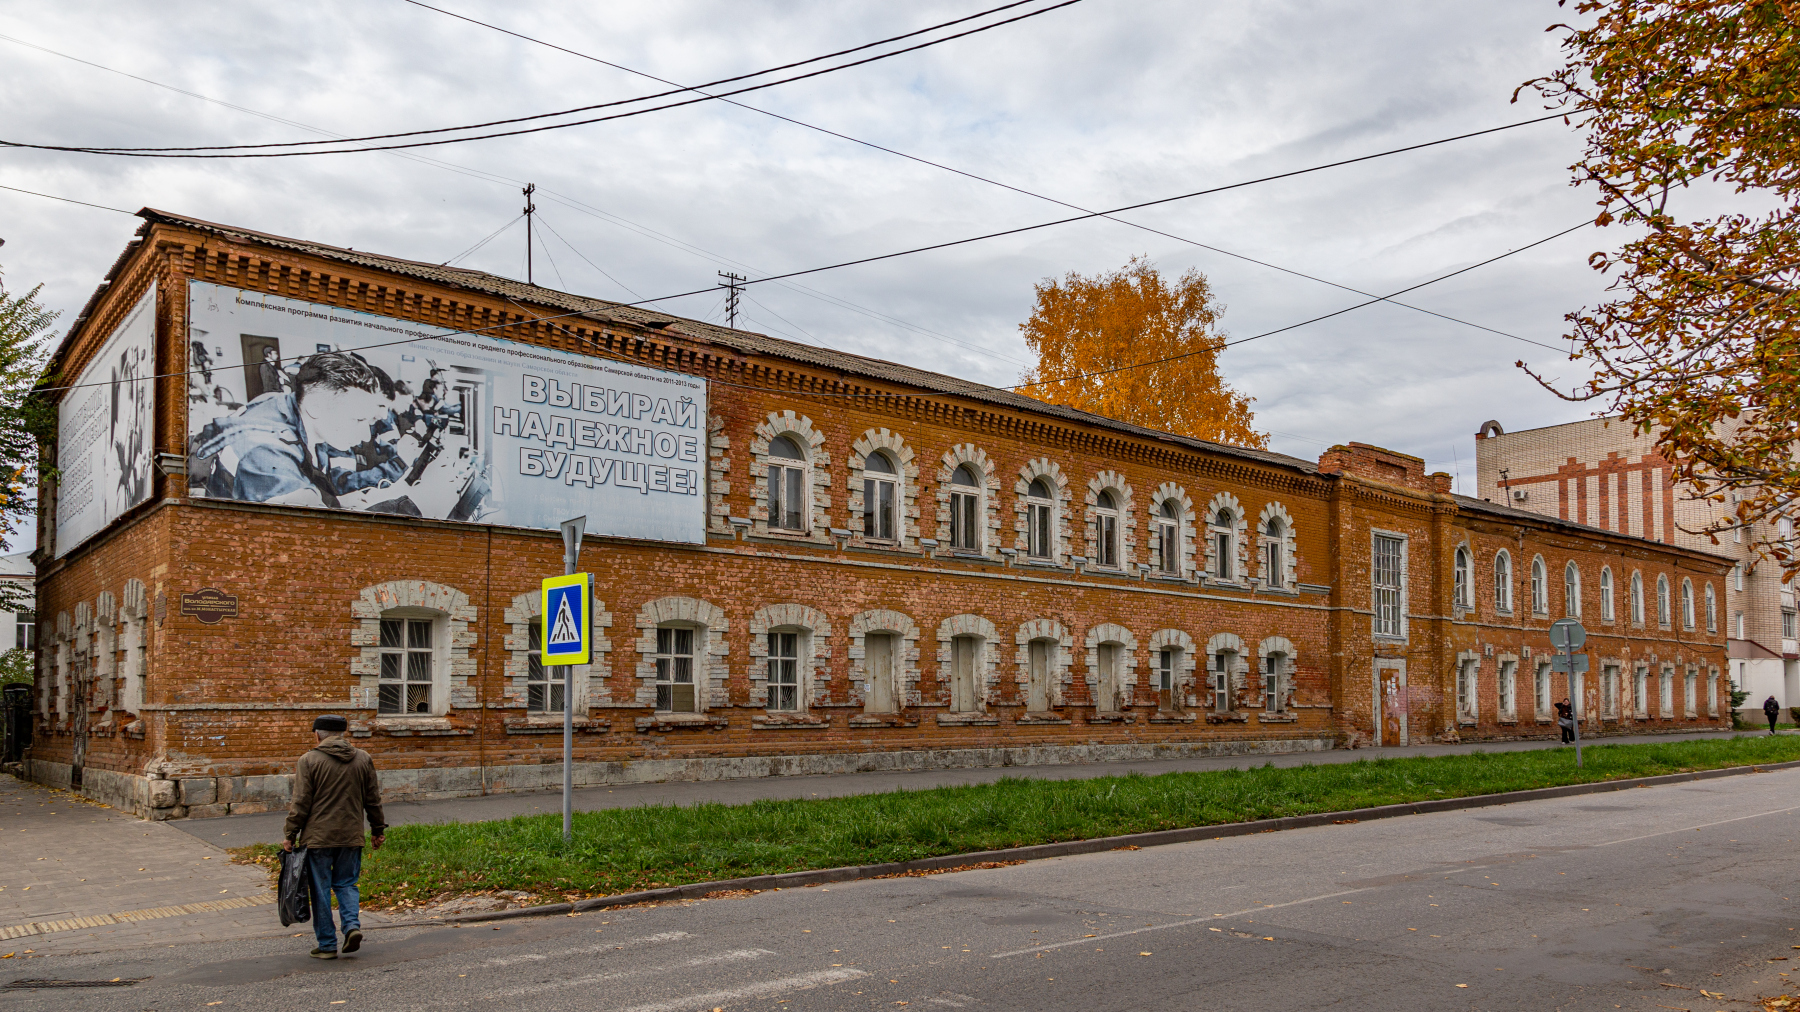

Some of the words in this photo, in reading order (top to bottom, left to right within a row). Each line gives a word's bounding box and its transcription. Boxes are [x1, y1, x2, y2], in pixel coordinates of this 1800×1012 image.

[236, 297, 285, 312] Комплексная
[287, 307, 328, 320] программа
[330, 316, 362, 326] развития
[364, 322, 403, 334] начального
[405, 330, 471, 347] профессионального
[478, 344, 506, 354] среднего
[507, 350, 566, 364] профессионального
[568, 360, 603, 372] образования
[604, 366, 633, 377] Самарской
[634, 372, 655, 382] области
[663, 377, 686, 386] 2011-2013
[522, 374, 697, 429] ВЫБИРАЙ
[494, 406, 698, 462] НАДЕЖНОЕ
[520, 446, 698, 496] БУДУЩЕЕ!
